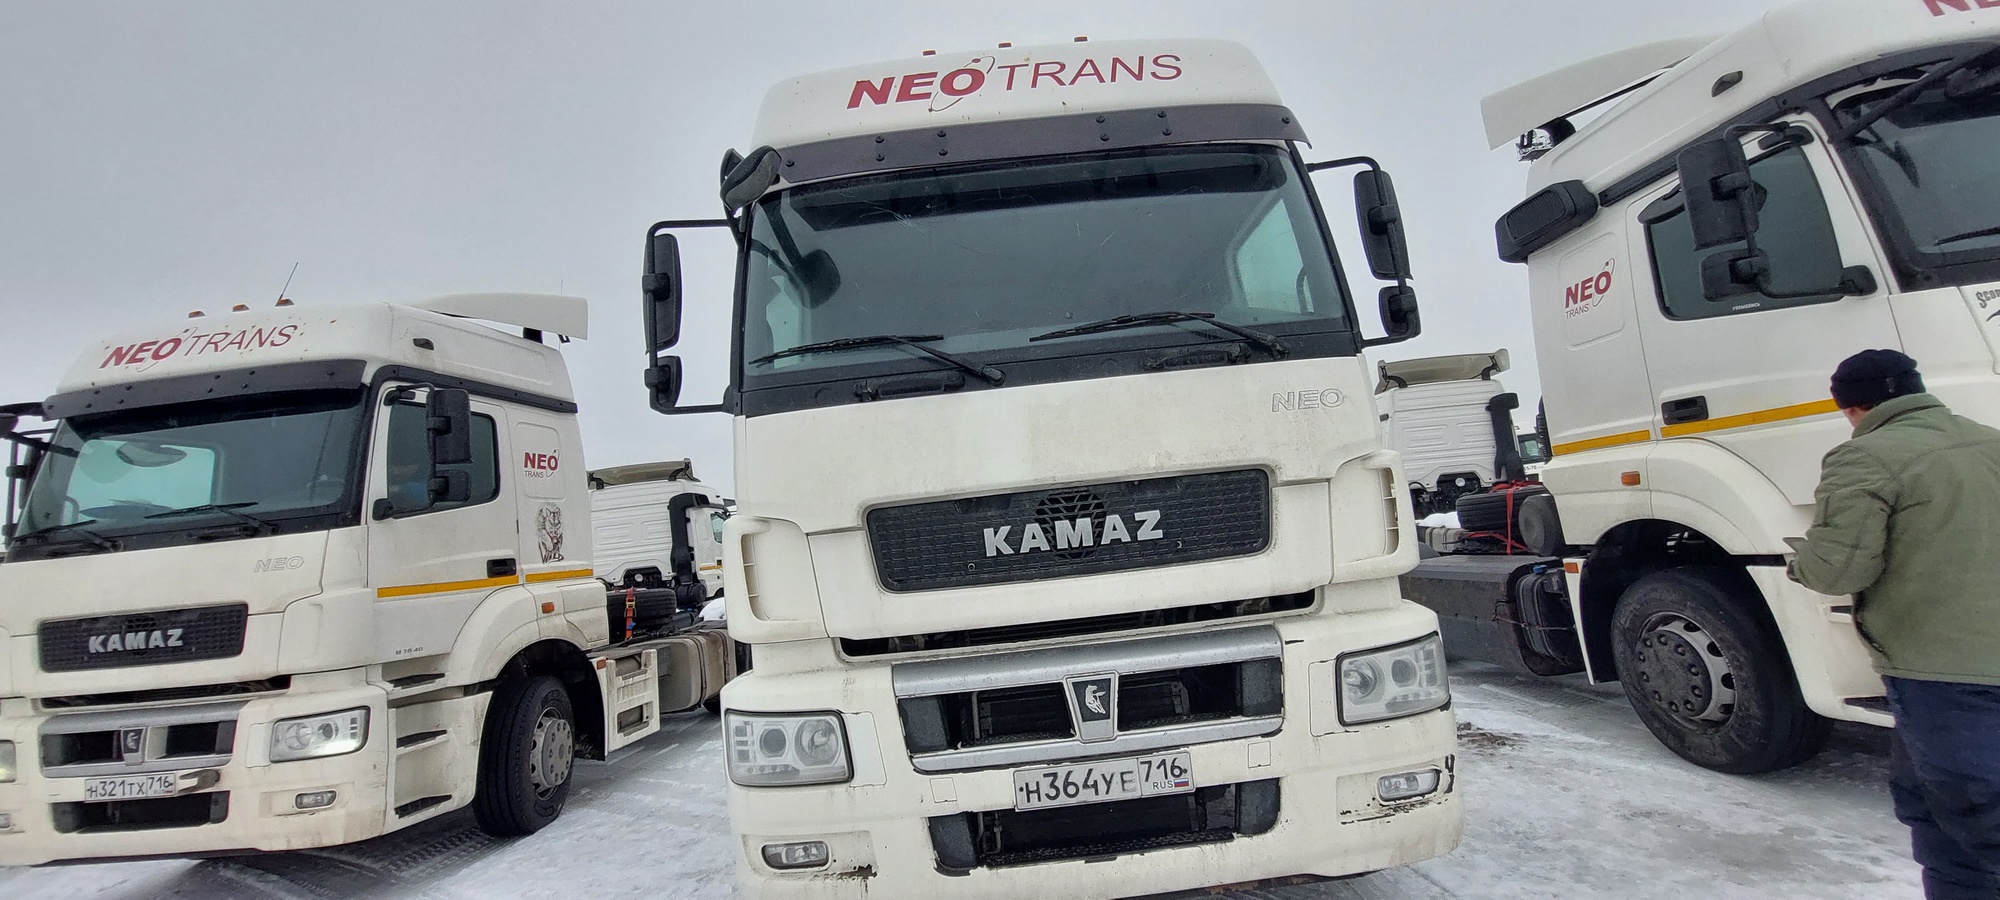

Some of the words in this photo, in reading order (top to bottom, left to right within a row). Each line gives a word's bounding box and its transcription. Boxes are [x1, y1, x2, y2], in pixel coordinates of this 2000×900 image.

[847, 68, 986, 109] NEO
[997, 54, 1183, 91] TRANS
[1565, 271, 1612, 309] NEO
[1565, 303, 1590, 319] TRANS
[99, 337, 183, 369] NEO
[184, 324, 298, 356] TRANS
[1271, 388, 1344, 412] NEO
[524, 452, 558, 471] NEO
[525, 470, 545, 478] TRANS
[983, 509, 1164, 557] KAMAZ
[253, 555, 304, 573] NEO
[88, 628, 184, 654] KAMAZ
[1139, 757, 1183, 783] 716
[148, 775, 171, 790] 716
[1152, 780, 1174, 790] RUS
